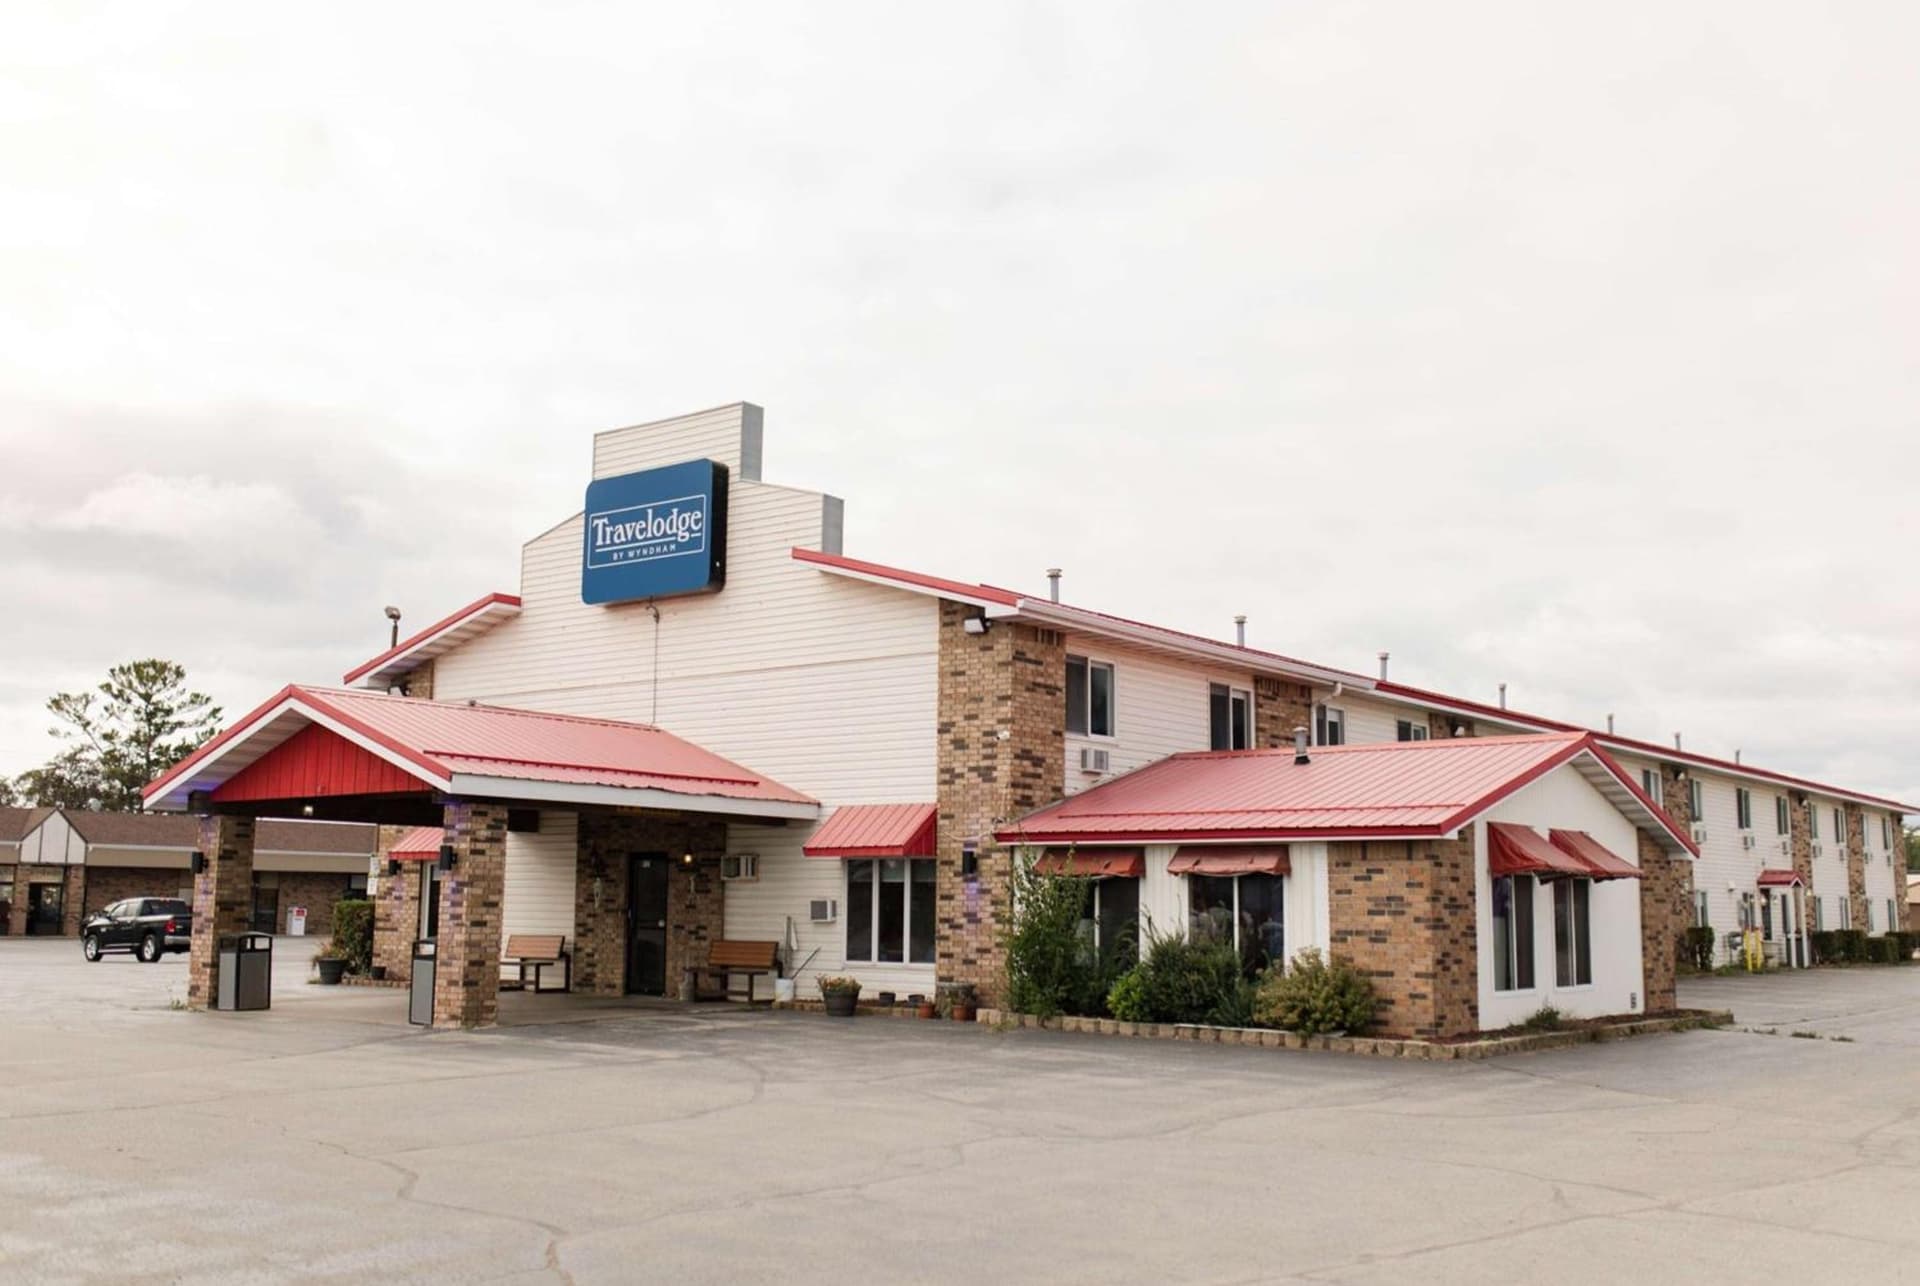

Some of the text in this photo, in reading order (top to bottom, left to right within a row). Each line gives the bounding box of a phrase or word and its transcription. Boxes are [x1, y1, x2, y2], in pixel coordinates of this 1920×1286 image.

[592, 508, 702, 546] Travelodge
[613, 544, 677, 561] BY WYNDHAM
